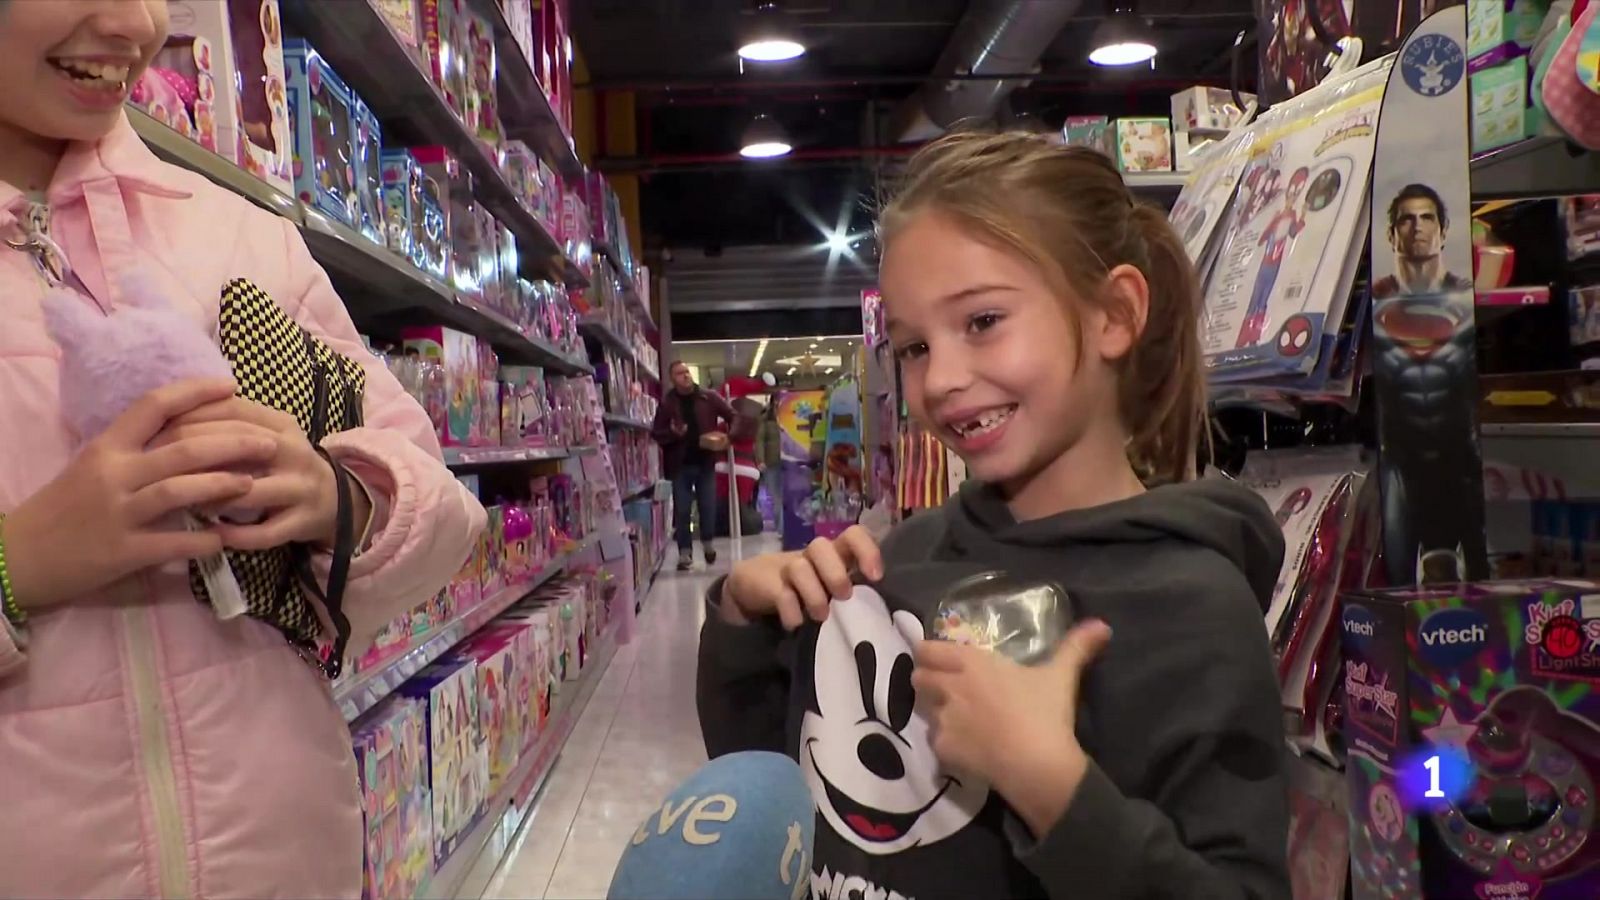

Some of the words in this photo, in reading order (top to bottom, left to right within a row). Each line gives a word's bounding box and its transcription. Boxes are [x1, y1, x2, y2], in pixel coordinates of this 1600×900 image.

[1403, 36, 1461, 65] RUBIES
[1343, 619, 1373, 637] vtech
[1421, 624, 1486, 646] vtech
